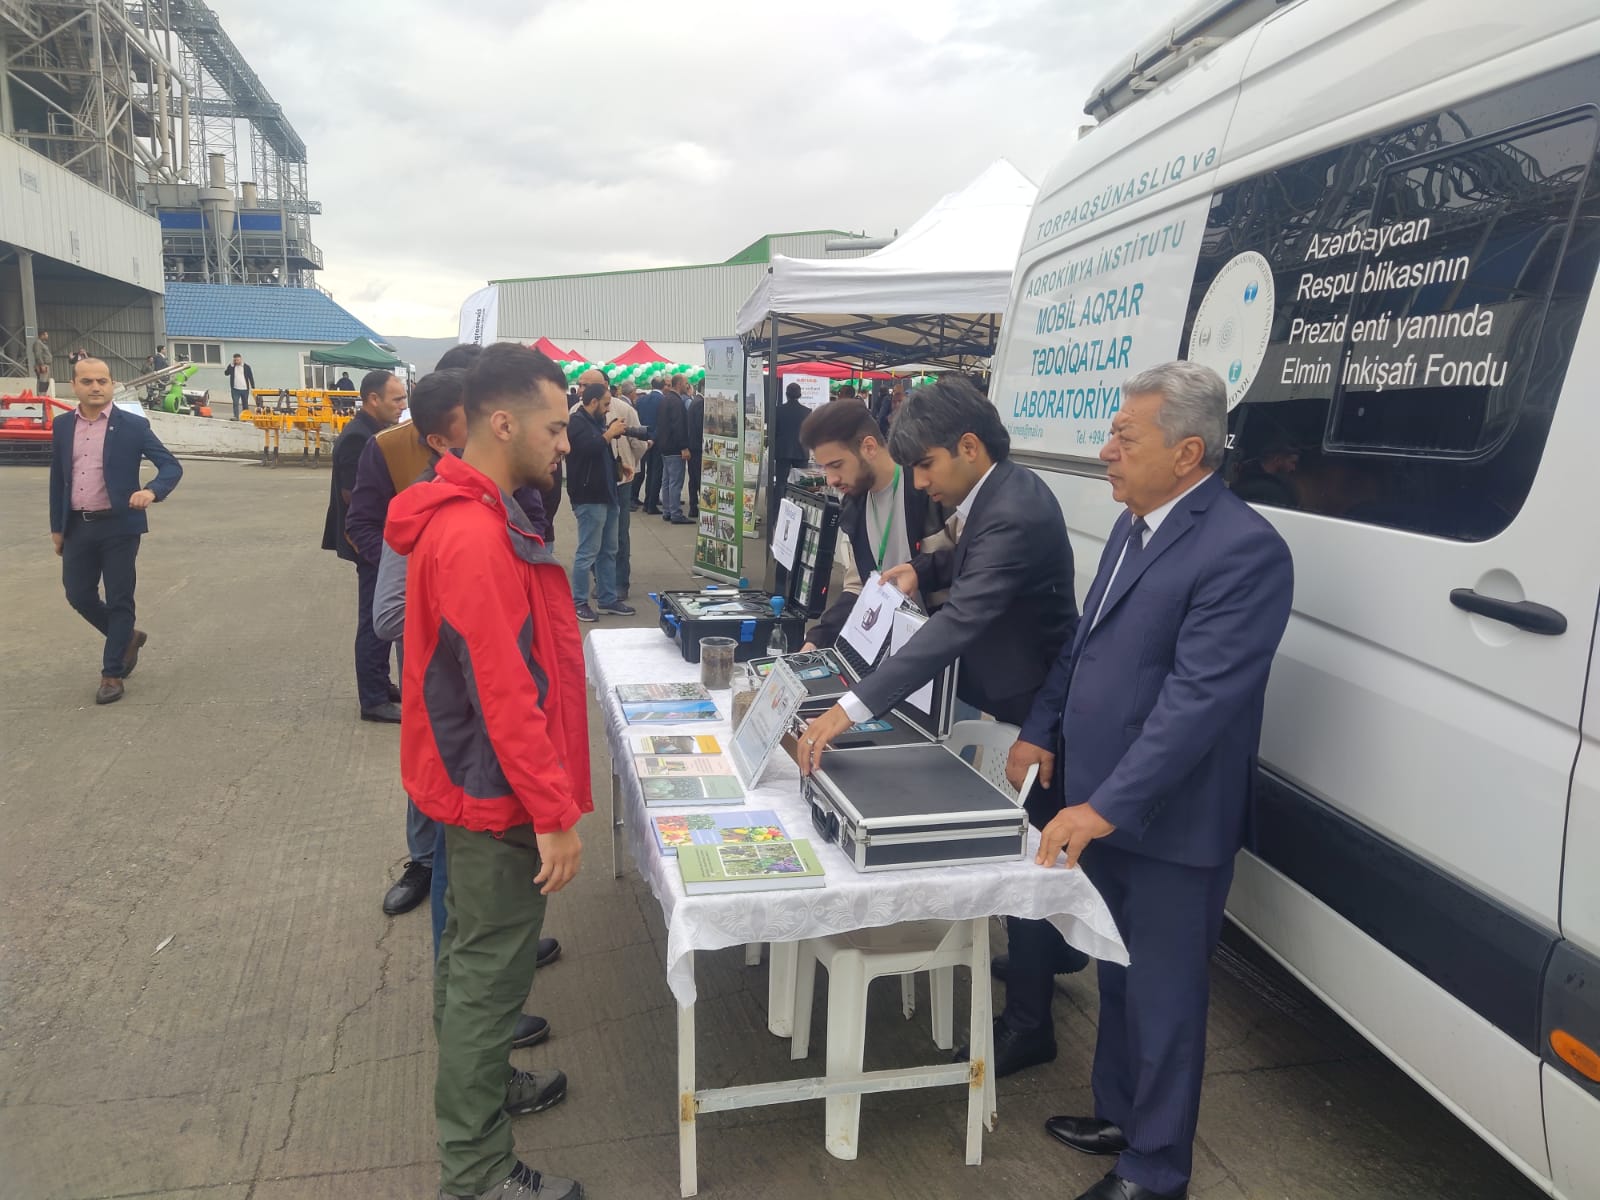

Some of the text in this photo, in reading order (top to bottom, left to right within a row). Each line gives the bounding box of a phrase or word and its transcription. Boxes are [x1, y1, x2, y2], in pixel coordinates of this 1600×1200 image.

[1036, 146, 1217, 241] TORPAQŞÜNASLIQ və
[1026, 219, 1186, 299] AQROKİMYA İNSTİTUTU
[1303, 216, 1431, 262] Azərbaycan
[1036, 282, 1144, 335] MOBİL AQRAR
[1392, 303, 1495, 349] yanında
[1031, 335, 1132, 377] TƏDQİQATLAR
[1280, 350, 1508, 393] Elmin İnkişafı Fondu
